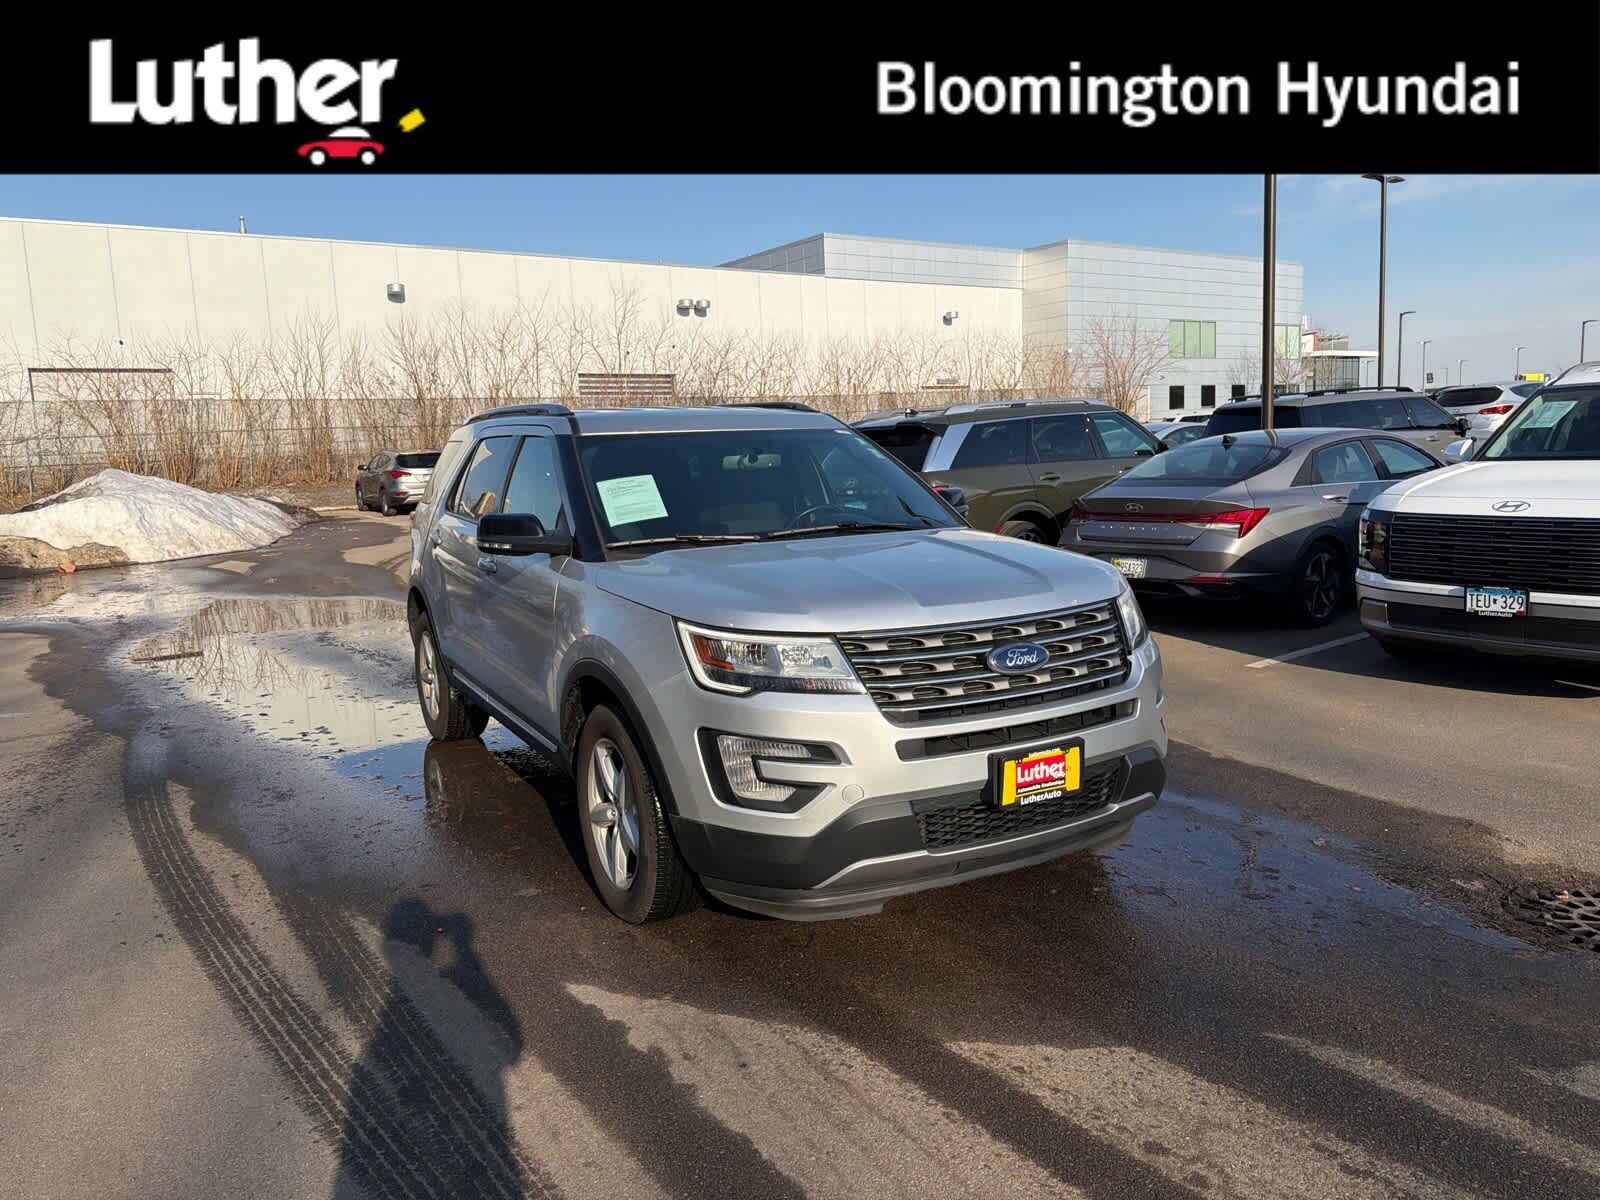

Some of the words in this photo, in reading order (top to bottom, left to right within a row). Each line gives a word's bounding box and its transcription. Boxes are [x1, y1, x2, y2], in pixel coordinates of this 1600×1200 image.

[1469, 594, 1491, 608] TEU
[1501, 595, 1524, 610] 329
[1006, 648, 1040, 667] Ford
[1017, 761, 1065, 783] Luther
[1020, 790, 1062, 805] LutherAuto
